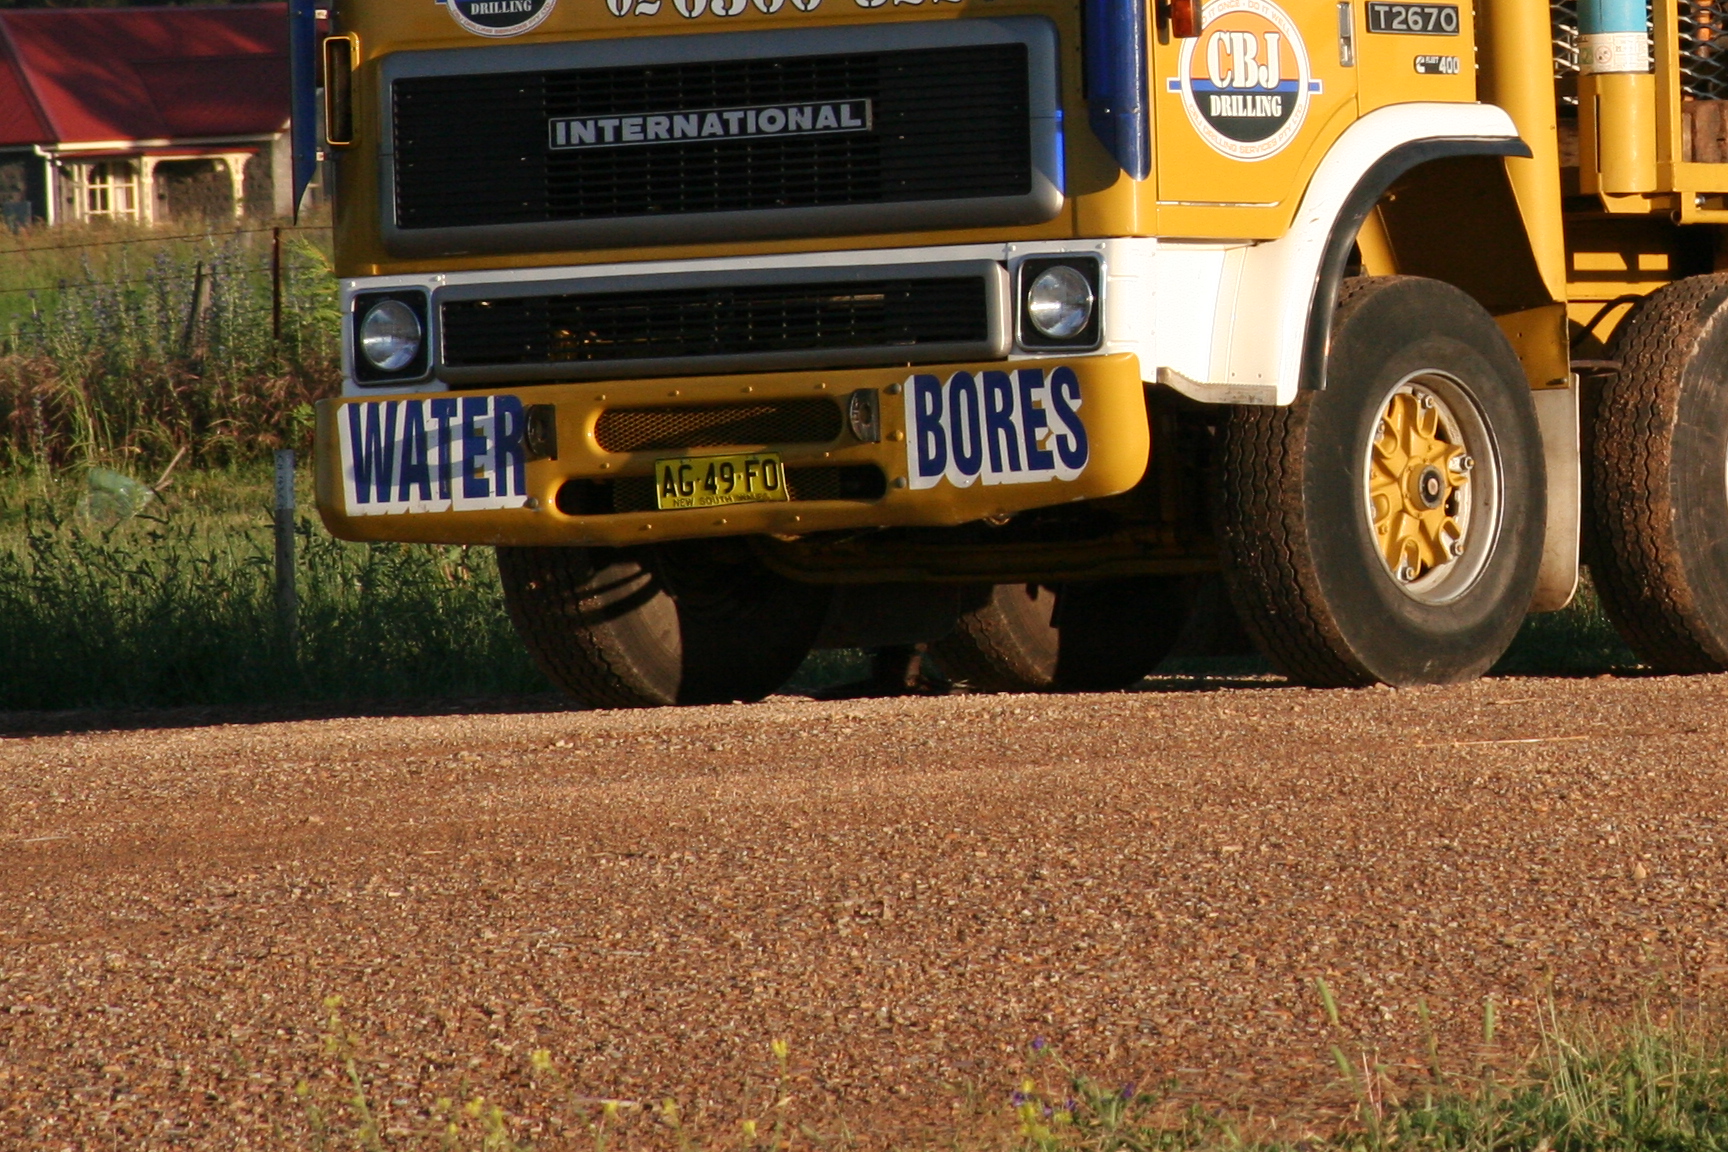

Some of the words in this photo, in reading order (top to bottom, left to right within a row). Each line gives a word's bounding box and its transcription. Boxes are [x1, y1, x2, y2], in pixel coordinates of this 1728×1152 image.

[471, 0, 532, 15] DRILLING
[1373, 4, 1457, 32] T2670
[1207, 31, 1280, 89] CBJ
[1438, 56, 1460, 74] 400
[1210, 94, 1282, 118] DRILLING
[556, 103, 862, 146] INTERNATIONAL
[344, 395, 527, 507] WATER
[911, 365, 1089, 480] BORES
[673, 497, 694, 507] NEW
[700, 495, 733, 506] SOUTH
